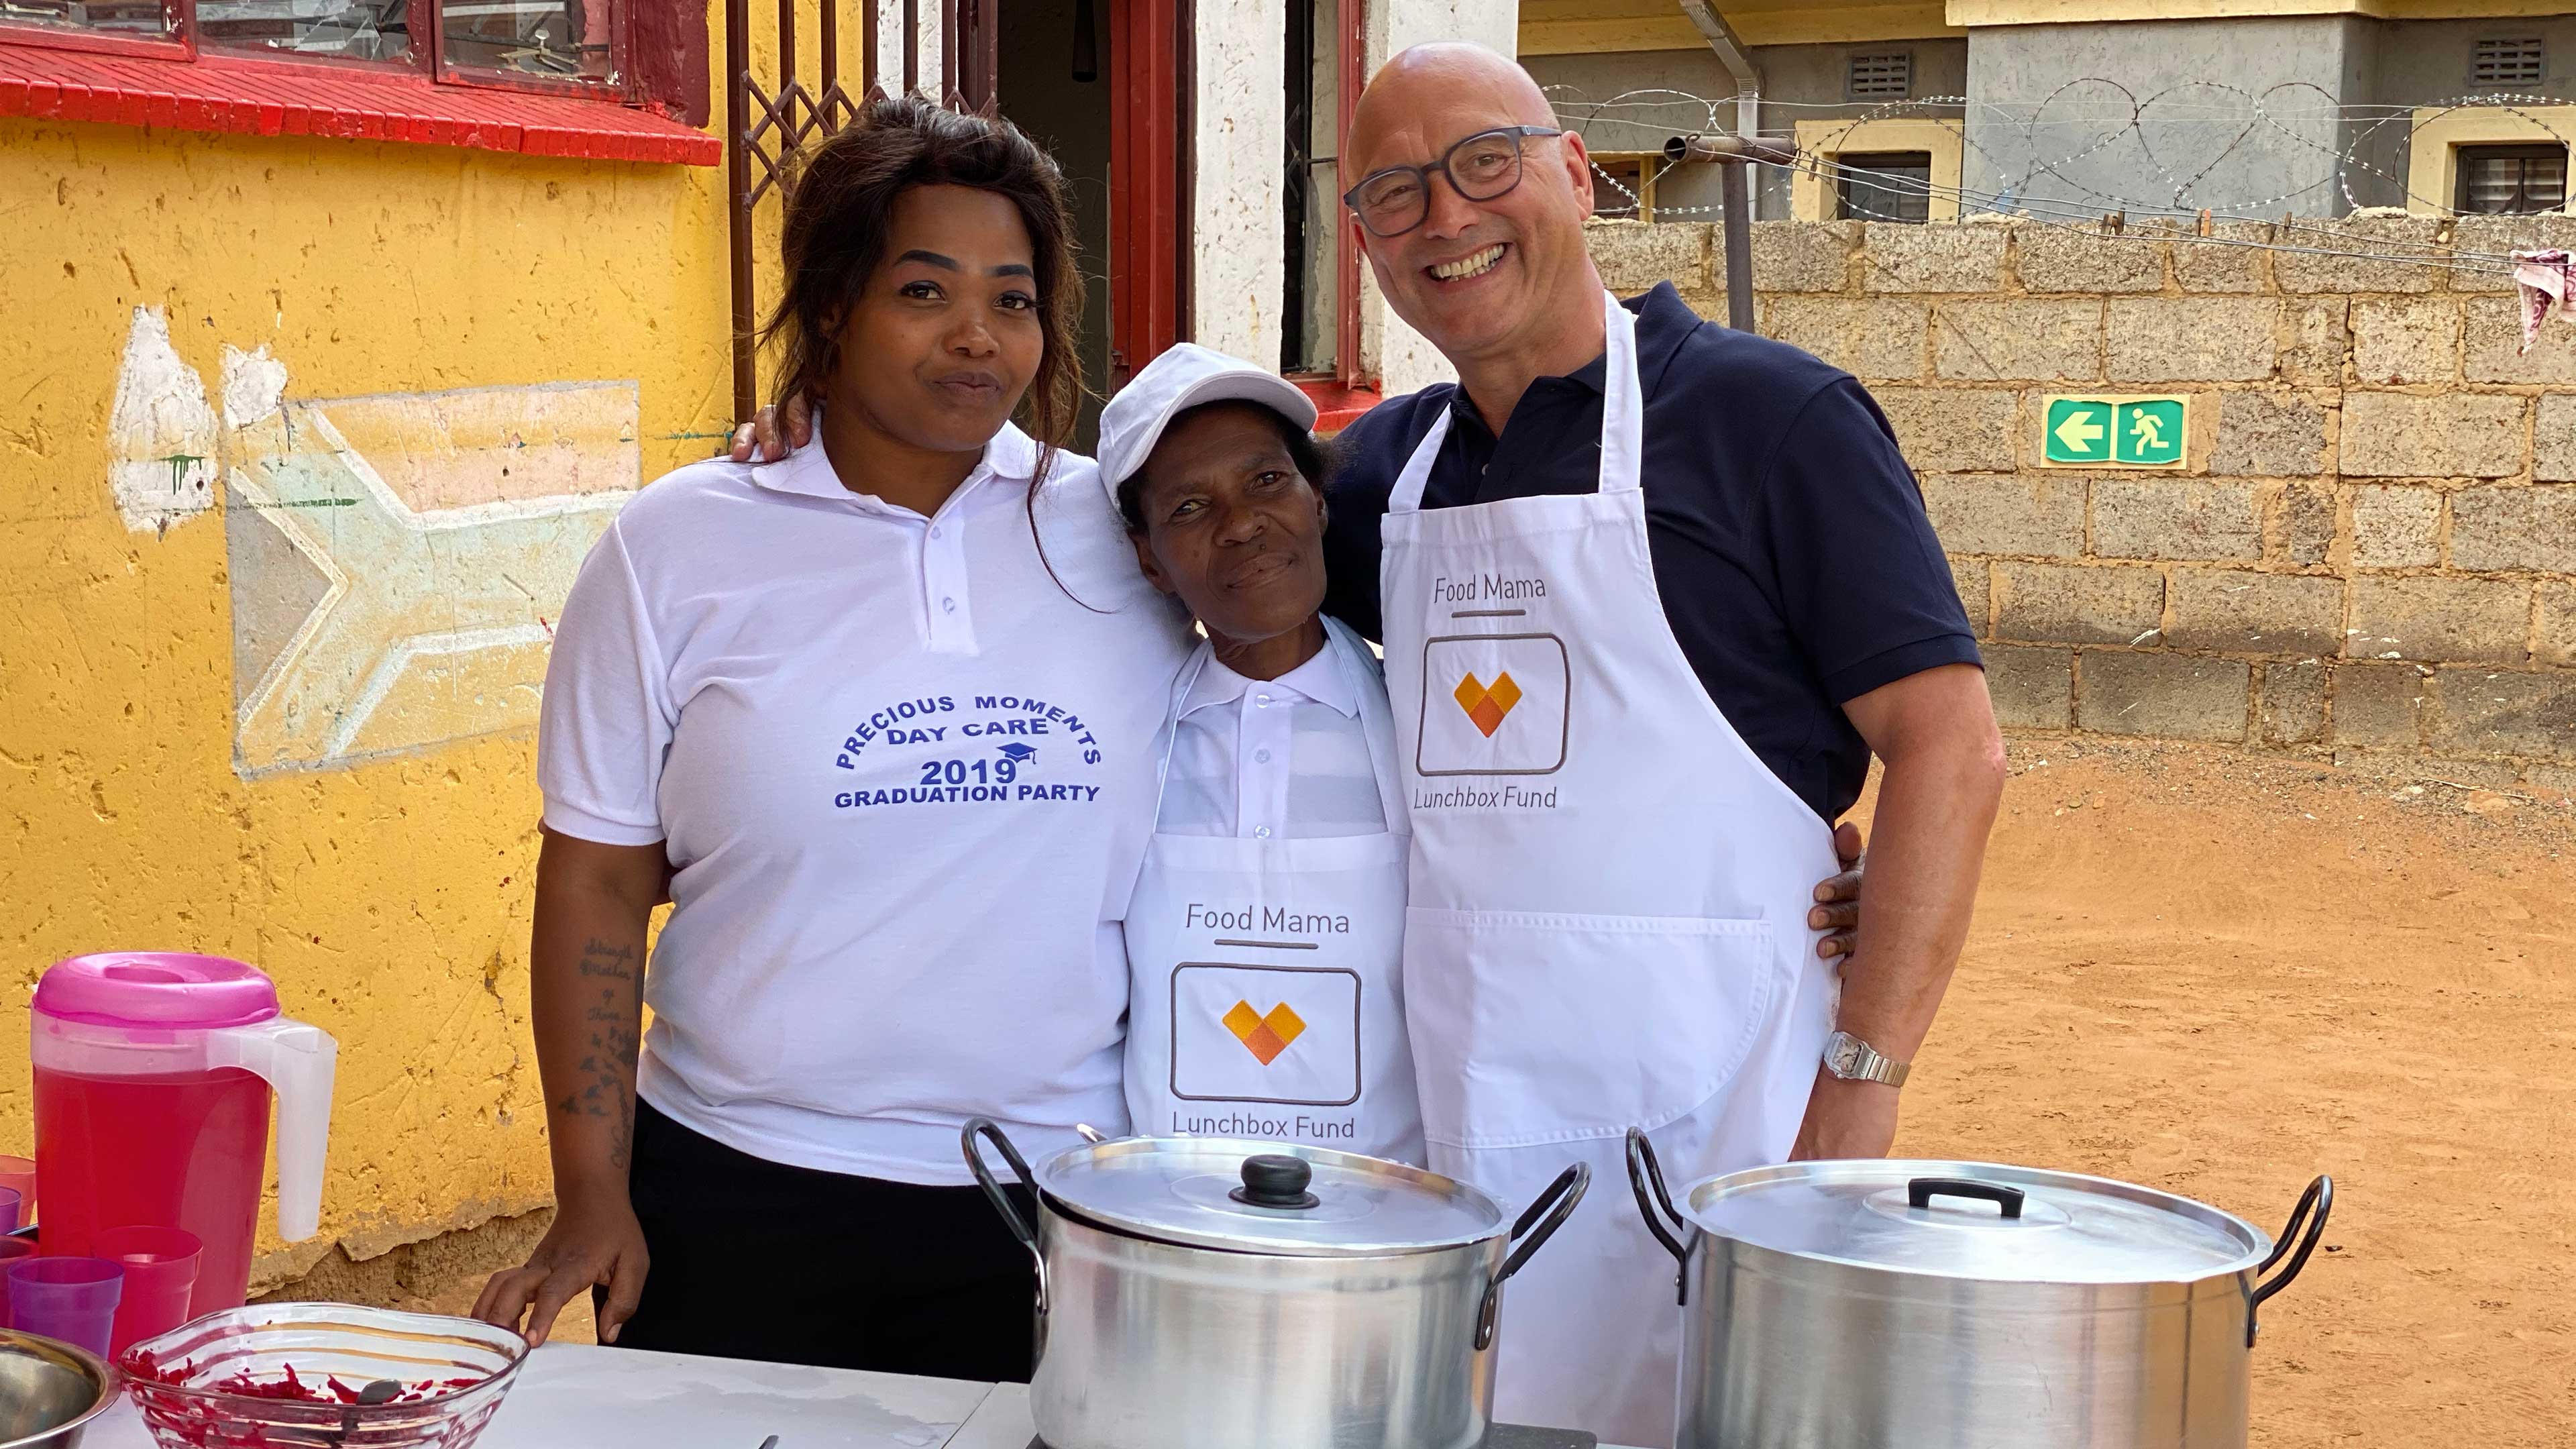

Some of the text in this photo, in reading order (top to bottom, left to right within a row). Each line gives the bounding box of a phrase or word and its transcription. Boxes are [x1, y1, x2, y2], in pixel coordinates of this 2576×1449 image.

[1434, 574, 1546, 604] Food Mama
[835, 696, 1102, 770] PRECIOUS MOMENTS
[885, 718, 1050, 745] DAY CARE
[919, 758, 1018, 786] 2019
[834, 784, 1102, 808] GRADUATION PARTY
[1413, 785, 1558, 810] Lunchbox Fund
[1185, 903, 1350, 934] Food Mama
[1173, 1110, 1355, 1139] Lunchbox Fund
